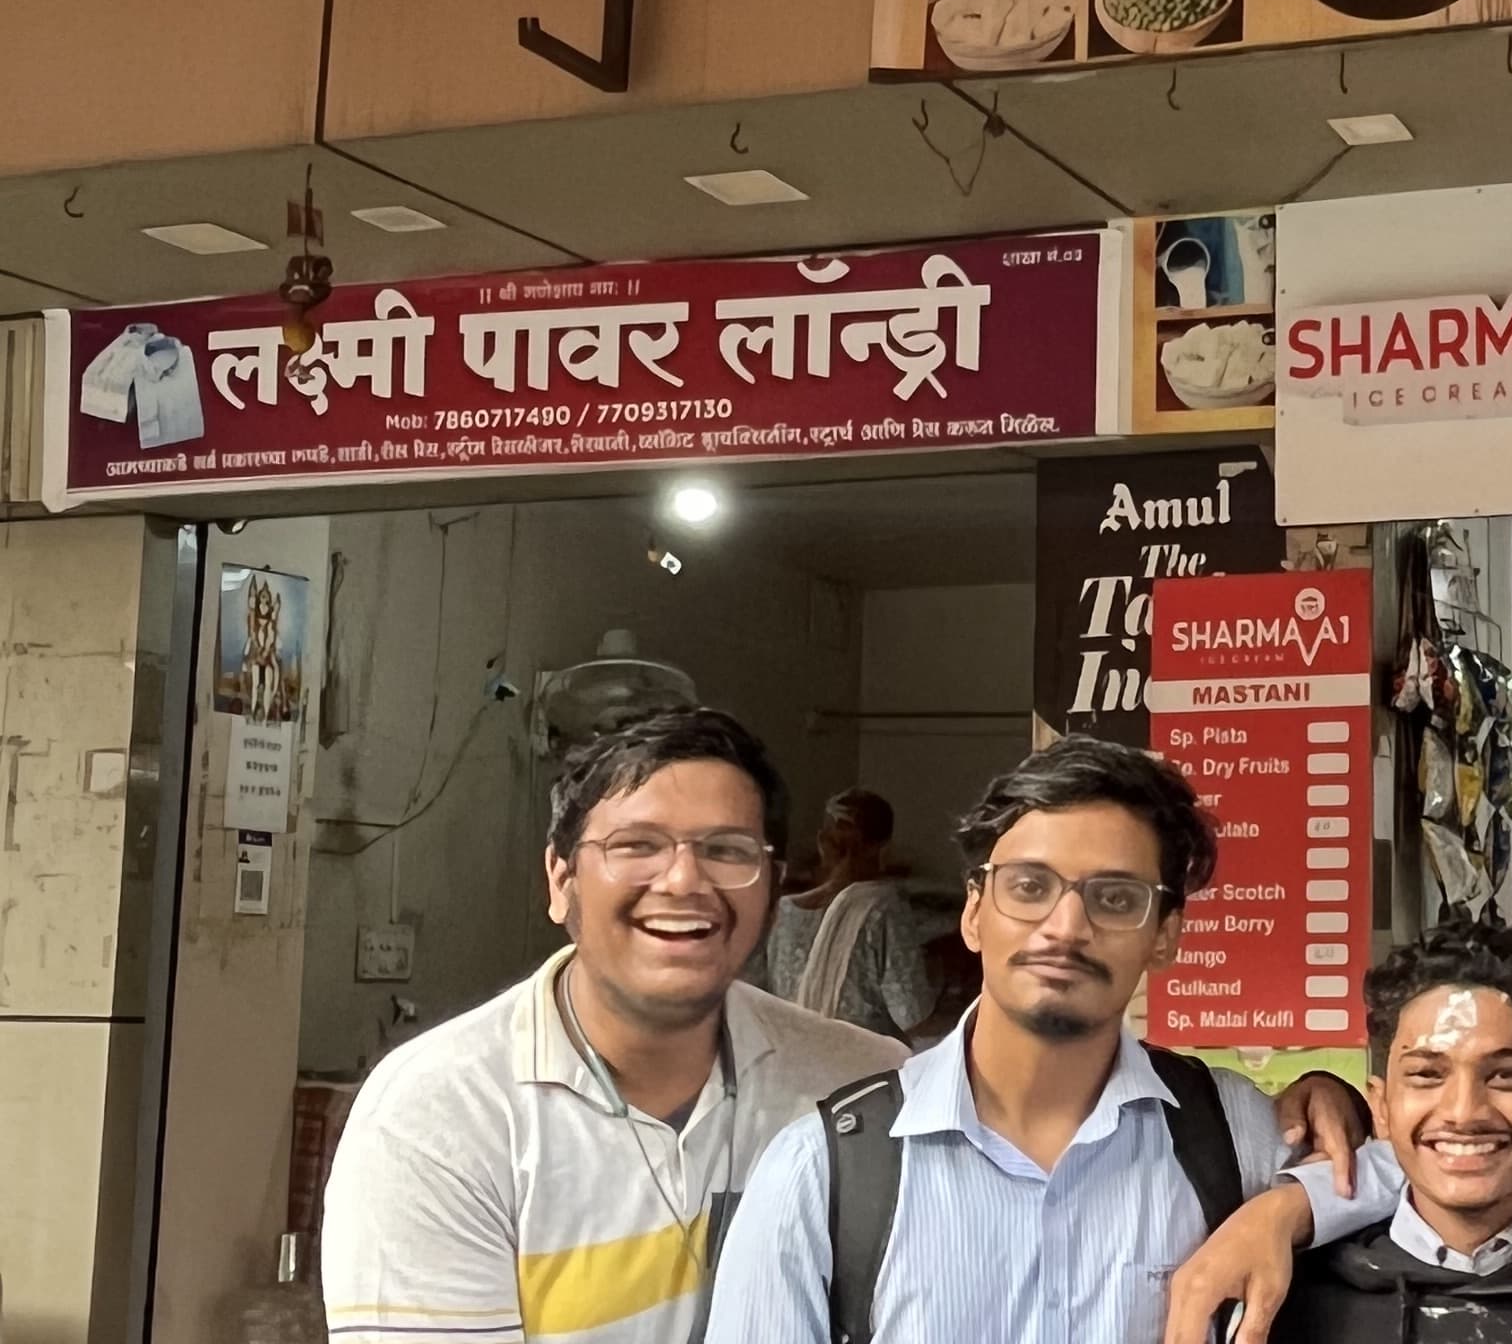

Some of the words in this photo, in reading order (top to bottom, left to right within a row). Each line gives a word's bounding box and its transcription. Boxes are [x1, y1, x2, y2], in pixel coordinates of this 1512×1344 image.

[459, 301, 690, 393] पावर
[715, 253, 992, 401] लॉन्ड्री
[596, 398, 733, 425] 7709317130
[1351, 389, 1405, 410] ICE
[1100, 479, 1232, 535] Amul
[1192, 682, 1311, 706] MASTANI
[1203, 726, 1248, 745] Pista
[1203, 757, 1235, 780] Dry
[1239, 756, 1290, 775] Fruits
[1223, 883, 1287, 901] Scotch
[1167, 978, 1242, 997] Gulkand
